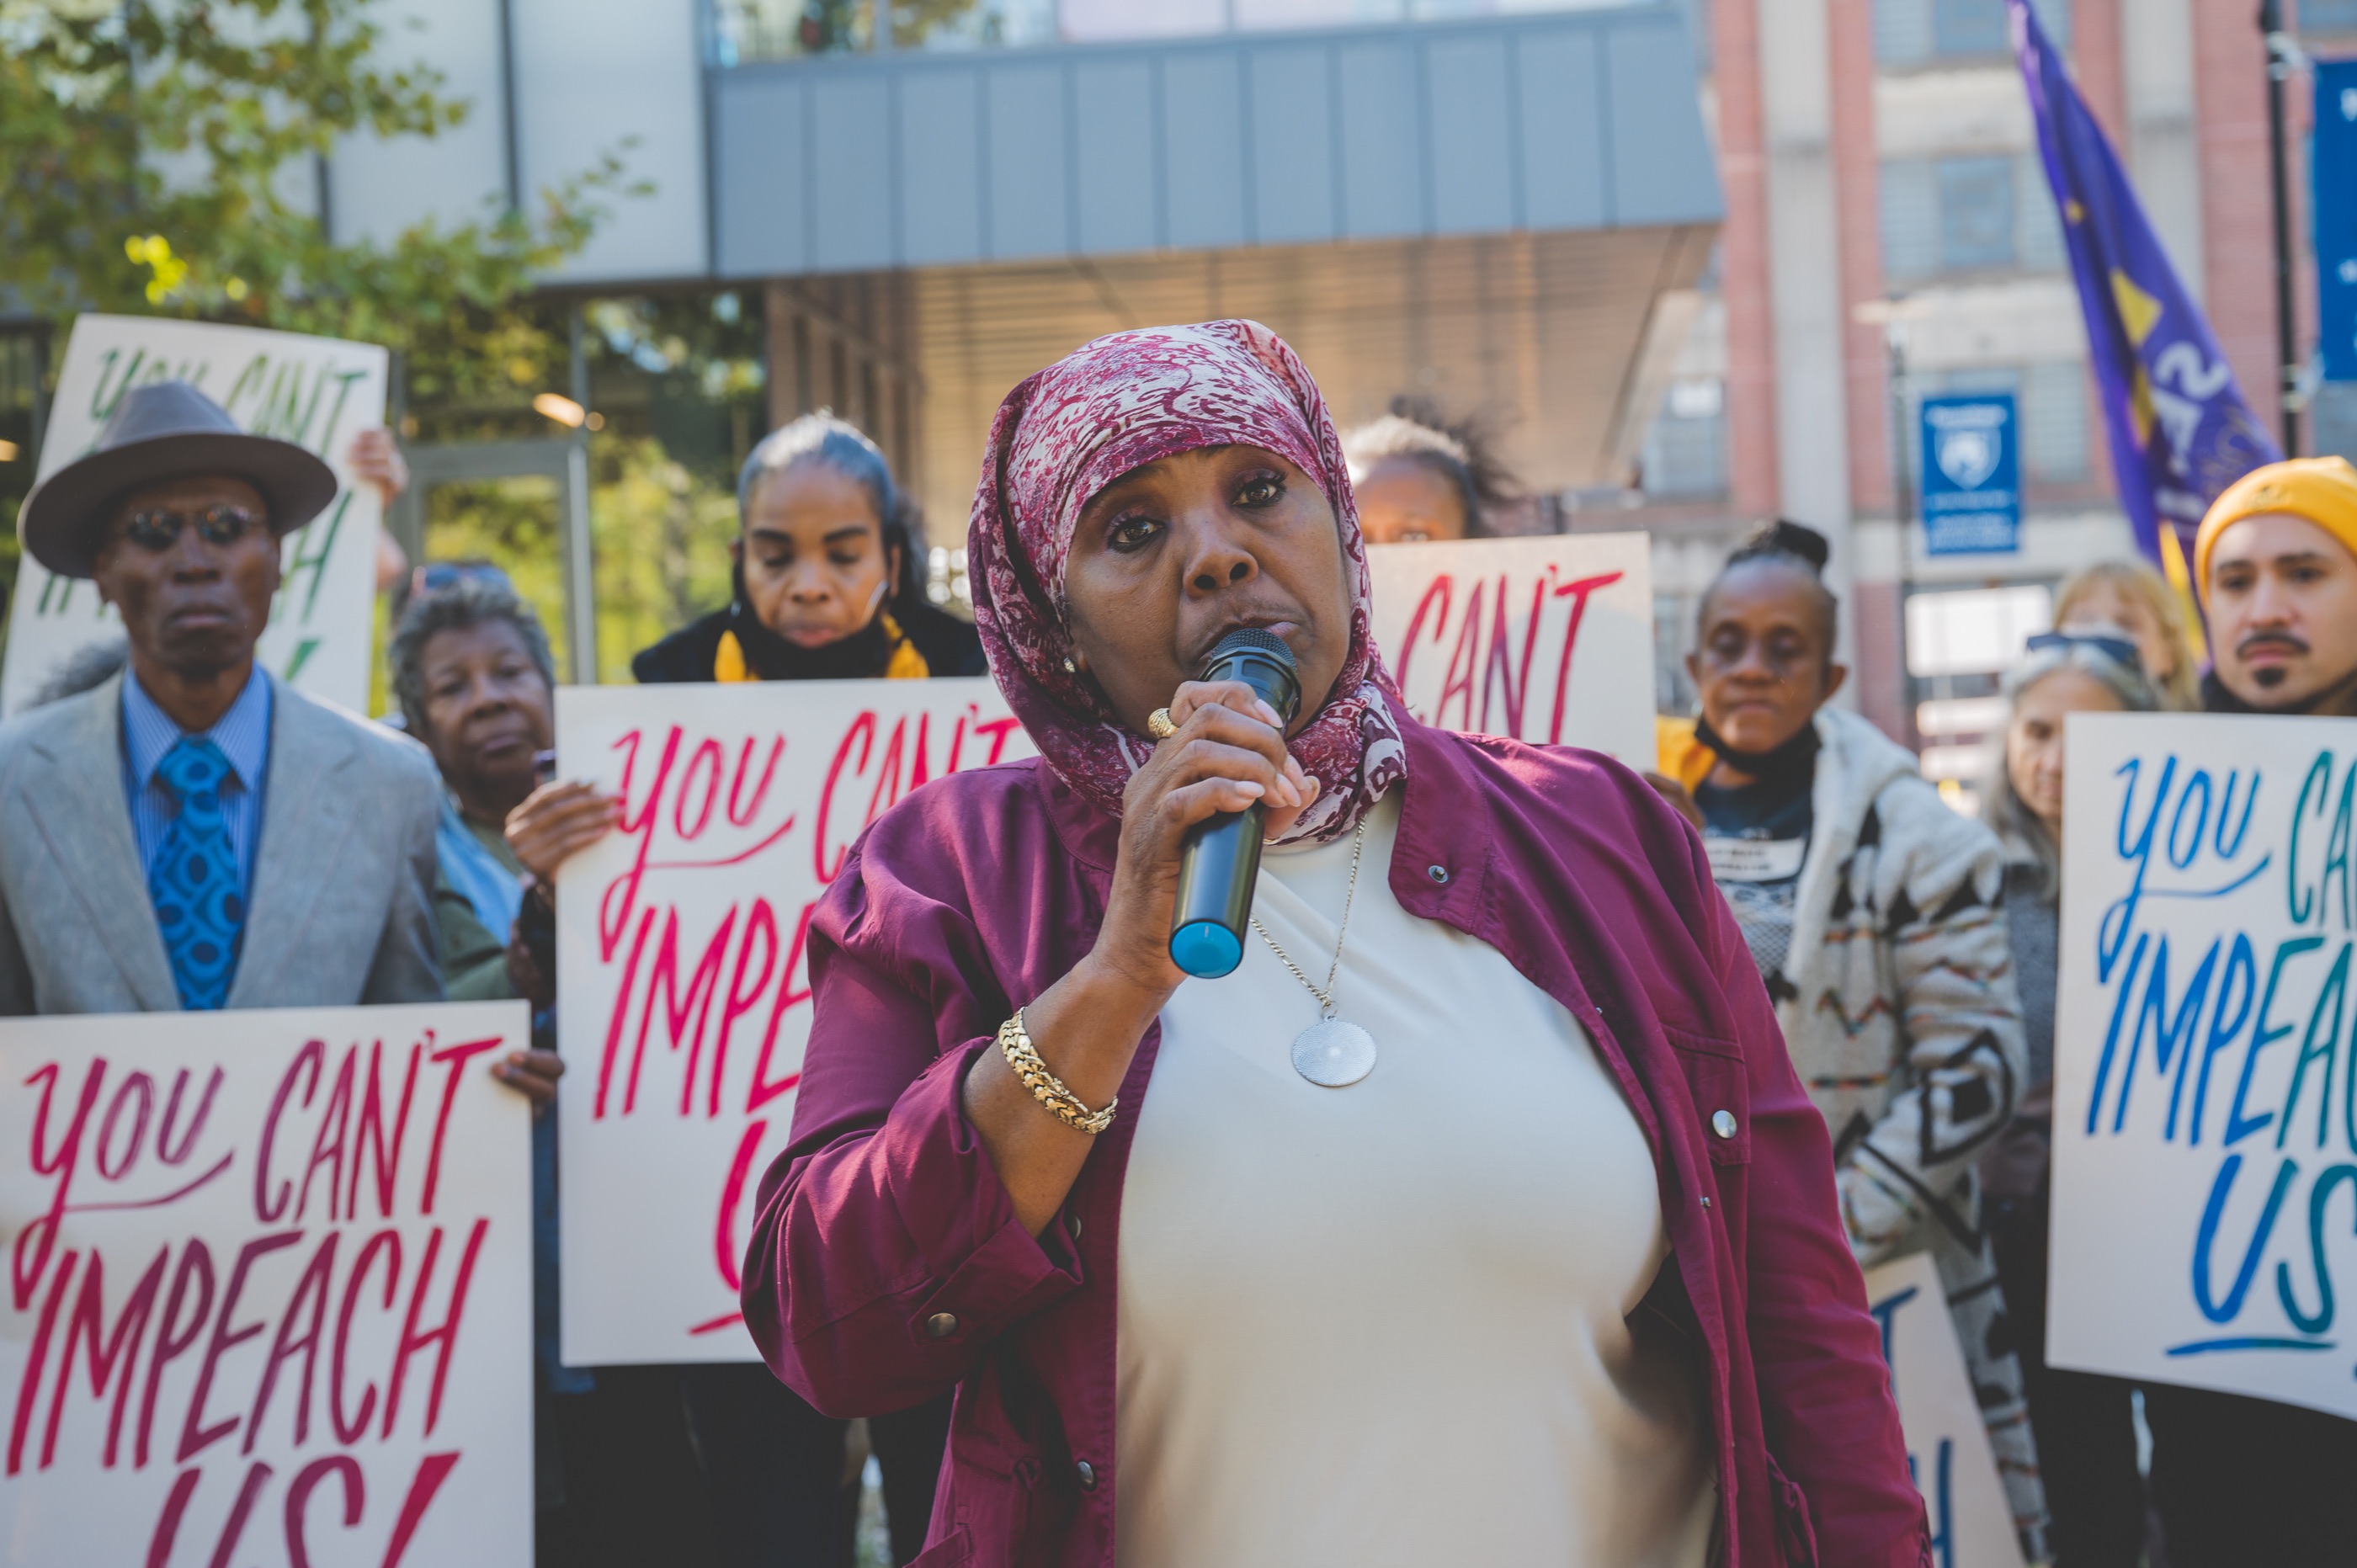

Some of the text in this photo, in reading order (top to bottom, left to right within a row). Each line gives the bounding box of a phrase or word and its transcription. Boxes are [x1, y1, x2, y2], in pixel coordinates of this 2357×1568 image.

[1395, 563, 1625, 746] CAN'T
[599, 725, 795, 965] YOU
[2097, 750, 2357, 985] YOU CA
[12, 1057, 235, 1311] YOU
[255, 1029, 504, 1224] CAN'T
[6, 1217, 490, 1478] IMPEACH
